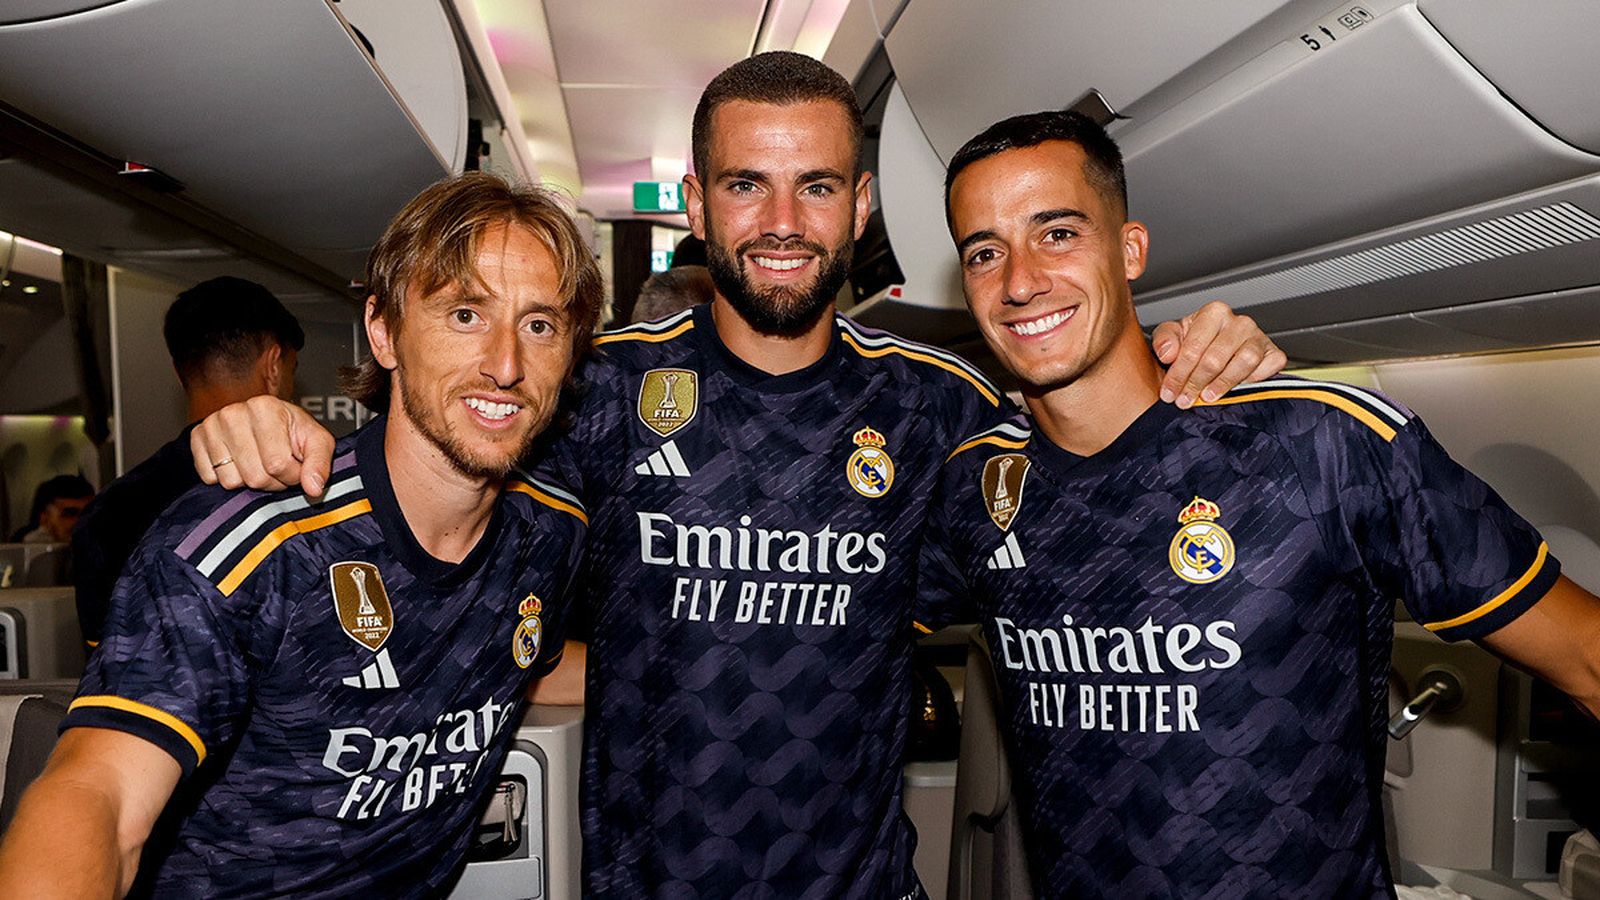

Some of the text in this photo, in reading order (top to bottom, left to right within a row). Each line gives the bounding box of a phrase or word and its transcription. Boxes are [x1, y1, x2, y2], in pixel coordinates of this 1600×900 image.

[1300, 33, 1321, 51] 5
[301, 396, 377, 420] ERI
[654, 409, 680, 418] FIFA
[993, 498, 1012, 512] FIFA
[636, 511, 887, 574] Emirates
[671, 577, 851, 626] FLY BETTER
[356, 616, 382, 627] FIFA
[995, 613, 1242, 674] Emirates
[1029, 682, 1201, 733] FLY BETTER
